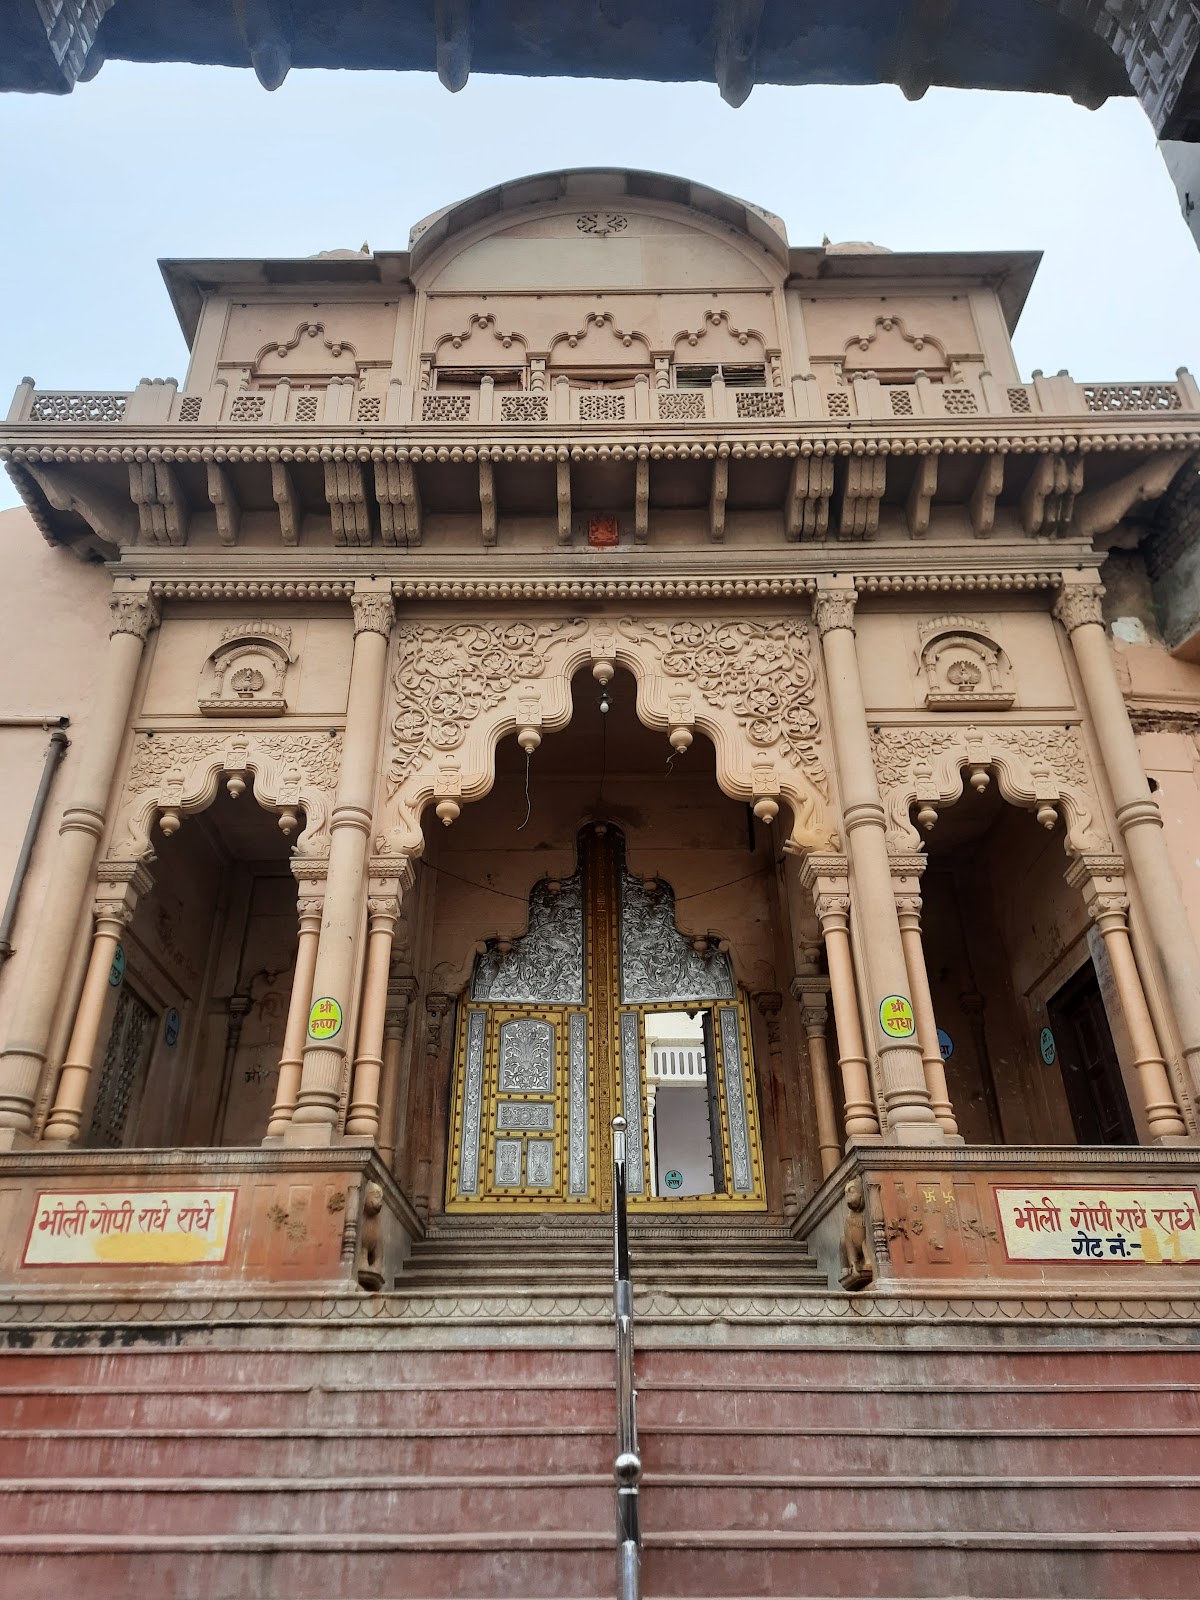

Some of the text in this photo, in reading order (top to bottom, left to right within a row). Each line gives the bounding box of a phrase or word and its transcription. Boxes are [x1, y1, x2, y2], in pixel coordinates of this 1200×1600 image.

[319, 1000, 333, 1013] श्री
[890, 999, 905, 1013] श्री
[887, 1017, 912, 1031] राधा
[38, 1199, 215, 1238] भोली गोपी राधे राधे
[1013, 1196, 1197, 1235] भोली गोपी राधे राधे
[1071, 1231, 1104, 1258] गेट
